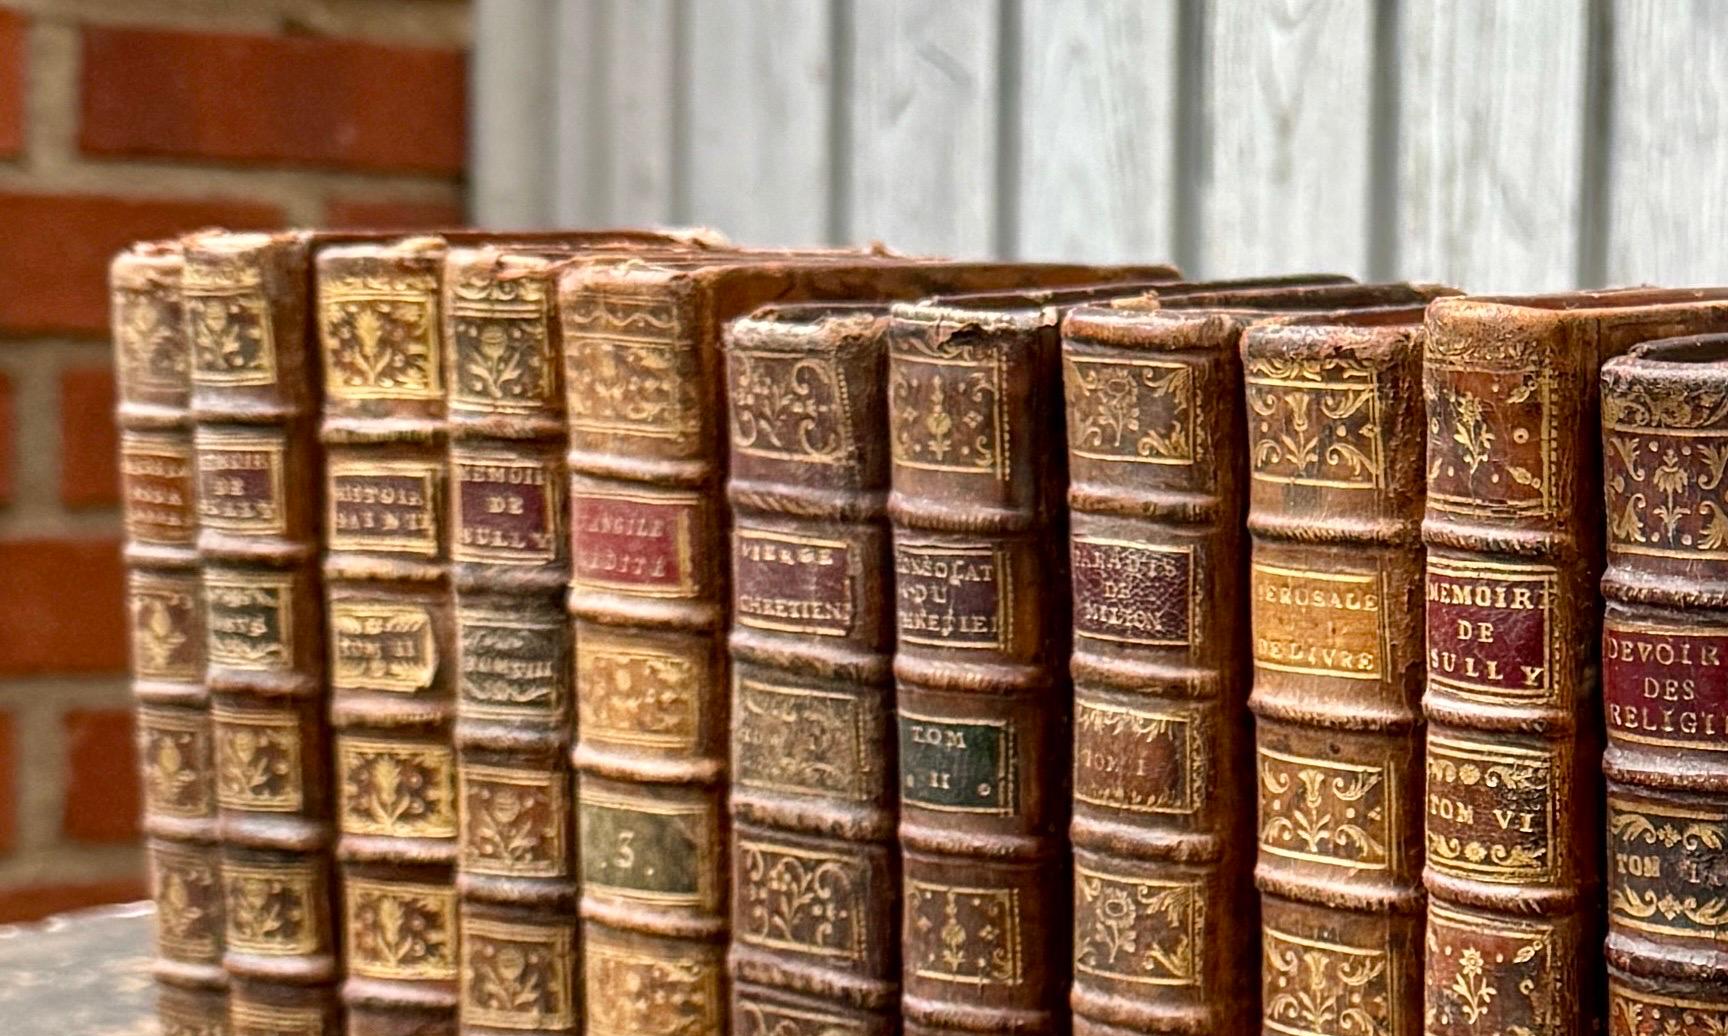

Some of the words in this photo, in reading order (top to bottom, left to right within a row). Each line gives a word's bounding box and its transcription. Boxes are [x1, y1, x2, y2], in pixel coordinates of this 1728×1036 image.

[1084, 601, 1163, 631] MILTON
[1457, 619, 1494, 643] DE
[1258, 638, 1374, 671] DELIVRE
[1430, 648, 1544, 687] SULLY
[1643, 677, 1695, 701] DES
[911, 726, 966, 749] TOM
[929, 772, 951, 789] II
[1430, 794, 1474, 825] TOM
[1493, 808, 1535, 833] VI
[1616, 853, 1661, 878] TOM
